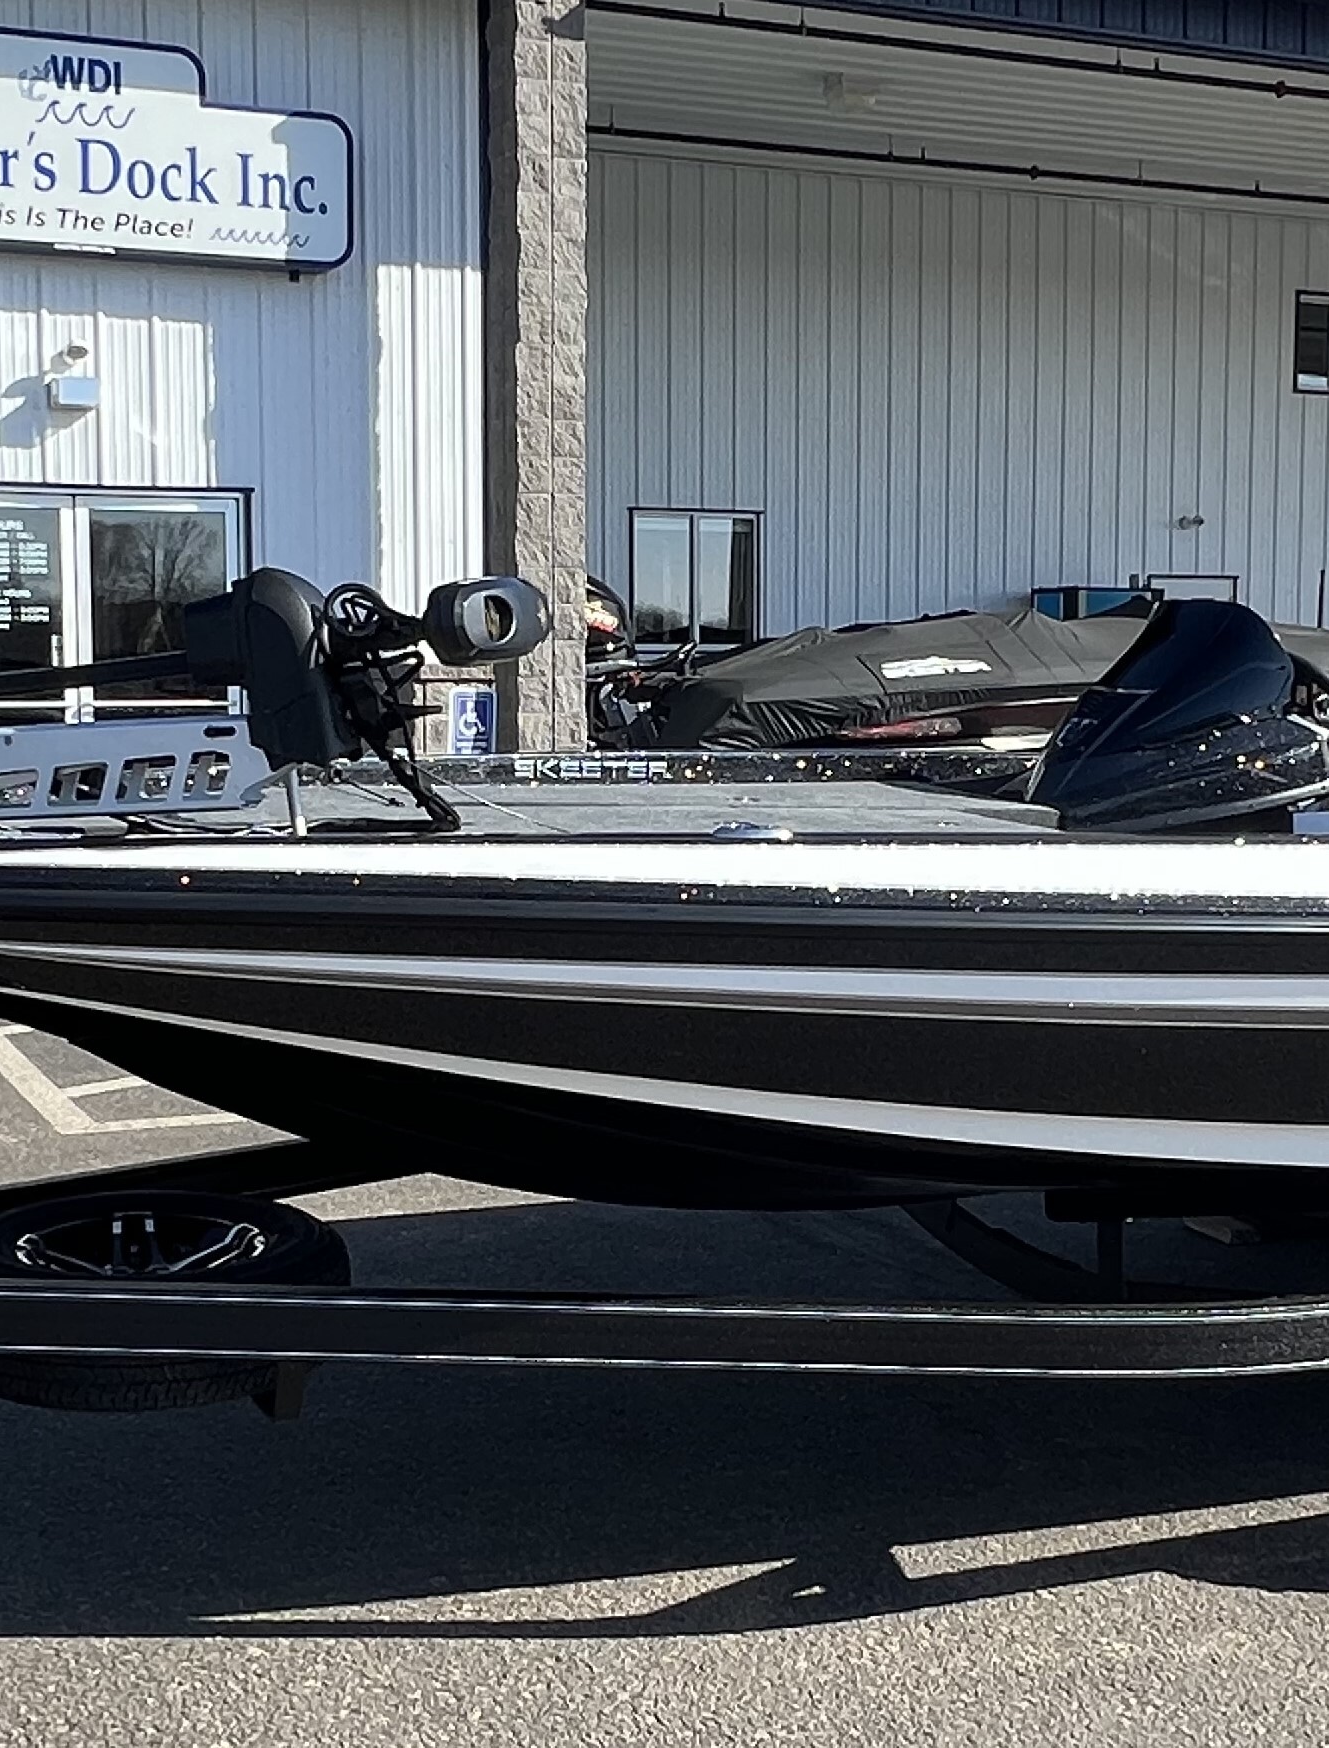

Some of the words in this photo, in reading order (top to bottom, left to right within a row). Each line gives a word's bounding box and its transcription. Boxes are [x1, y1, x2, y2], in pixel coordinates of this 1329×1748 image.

[51, 54, 122, 95] WDI
[75, 137, 219, 204] Dock
[236, 151, 328, 215] Inc.
[25, 206, 46, 227] Is
[56, 207, 106, 232] The
[114, 212, 194, 239] Place!
[514, 758, 673, 779] SKEETER
